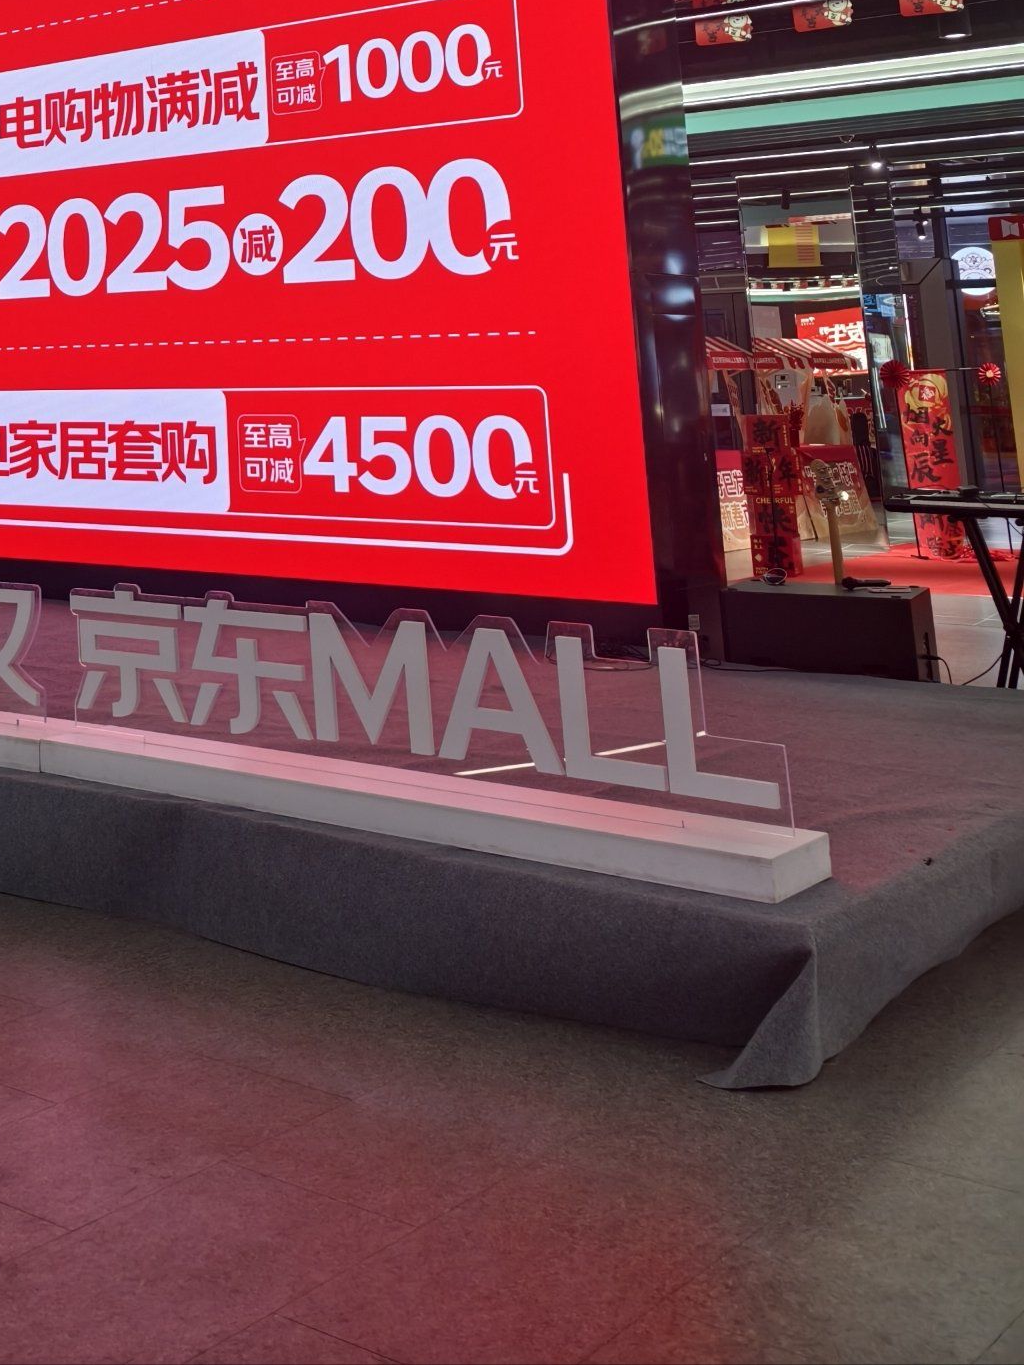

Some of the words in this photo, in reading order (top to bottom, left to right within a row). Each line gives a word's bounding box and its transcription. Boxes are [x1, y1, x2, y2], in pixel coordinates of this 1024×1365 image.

[275, 57, 315, 81] 至高
[276, 82, 317, 106] 可减
[239, 227, 277, 264] 减
[243, 422, 293, 451] 至高
[245, 455, 295, 485] 可减
[755, 496, 795, 505] CHERFUL
[69, 590, 783, 816] 京东MALL
